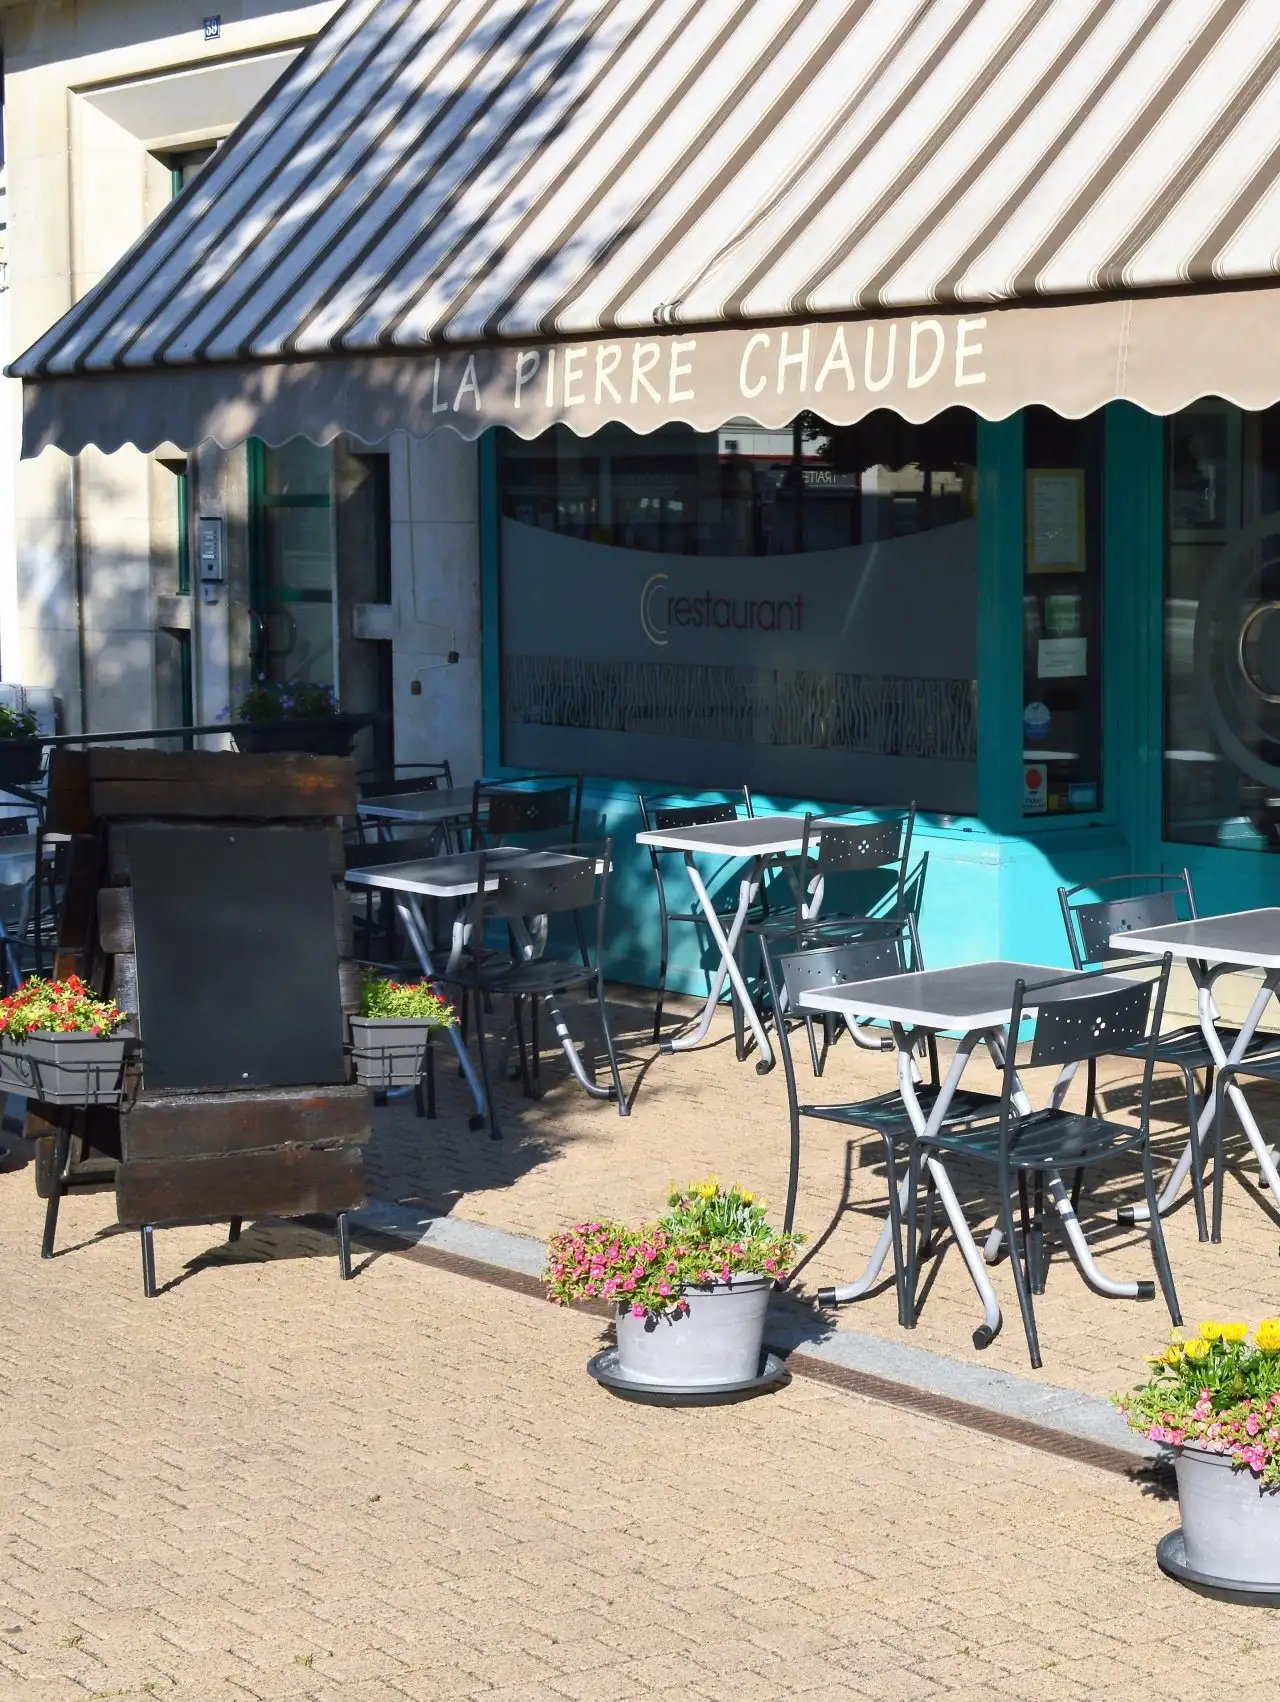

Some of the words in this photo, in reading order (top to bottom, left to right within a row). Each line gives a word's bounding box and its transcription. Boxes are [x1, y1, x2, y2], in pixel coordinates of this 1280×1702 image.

[431, 352, 482, 414] LA
[513, 341, 697, 409] PIERRE
[739, 318, 988, 398] CHAUDE
[667, 590, 804, 631] restaurant
